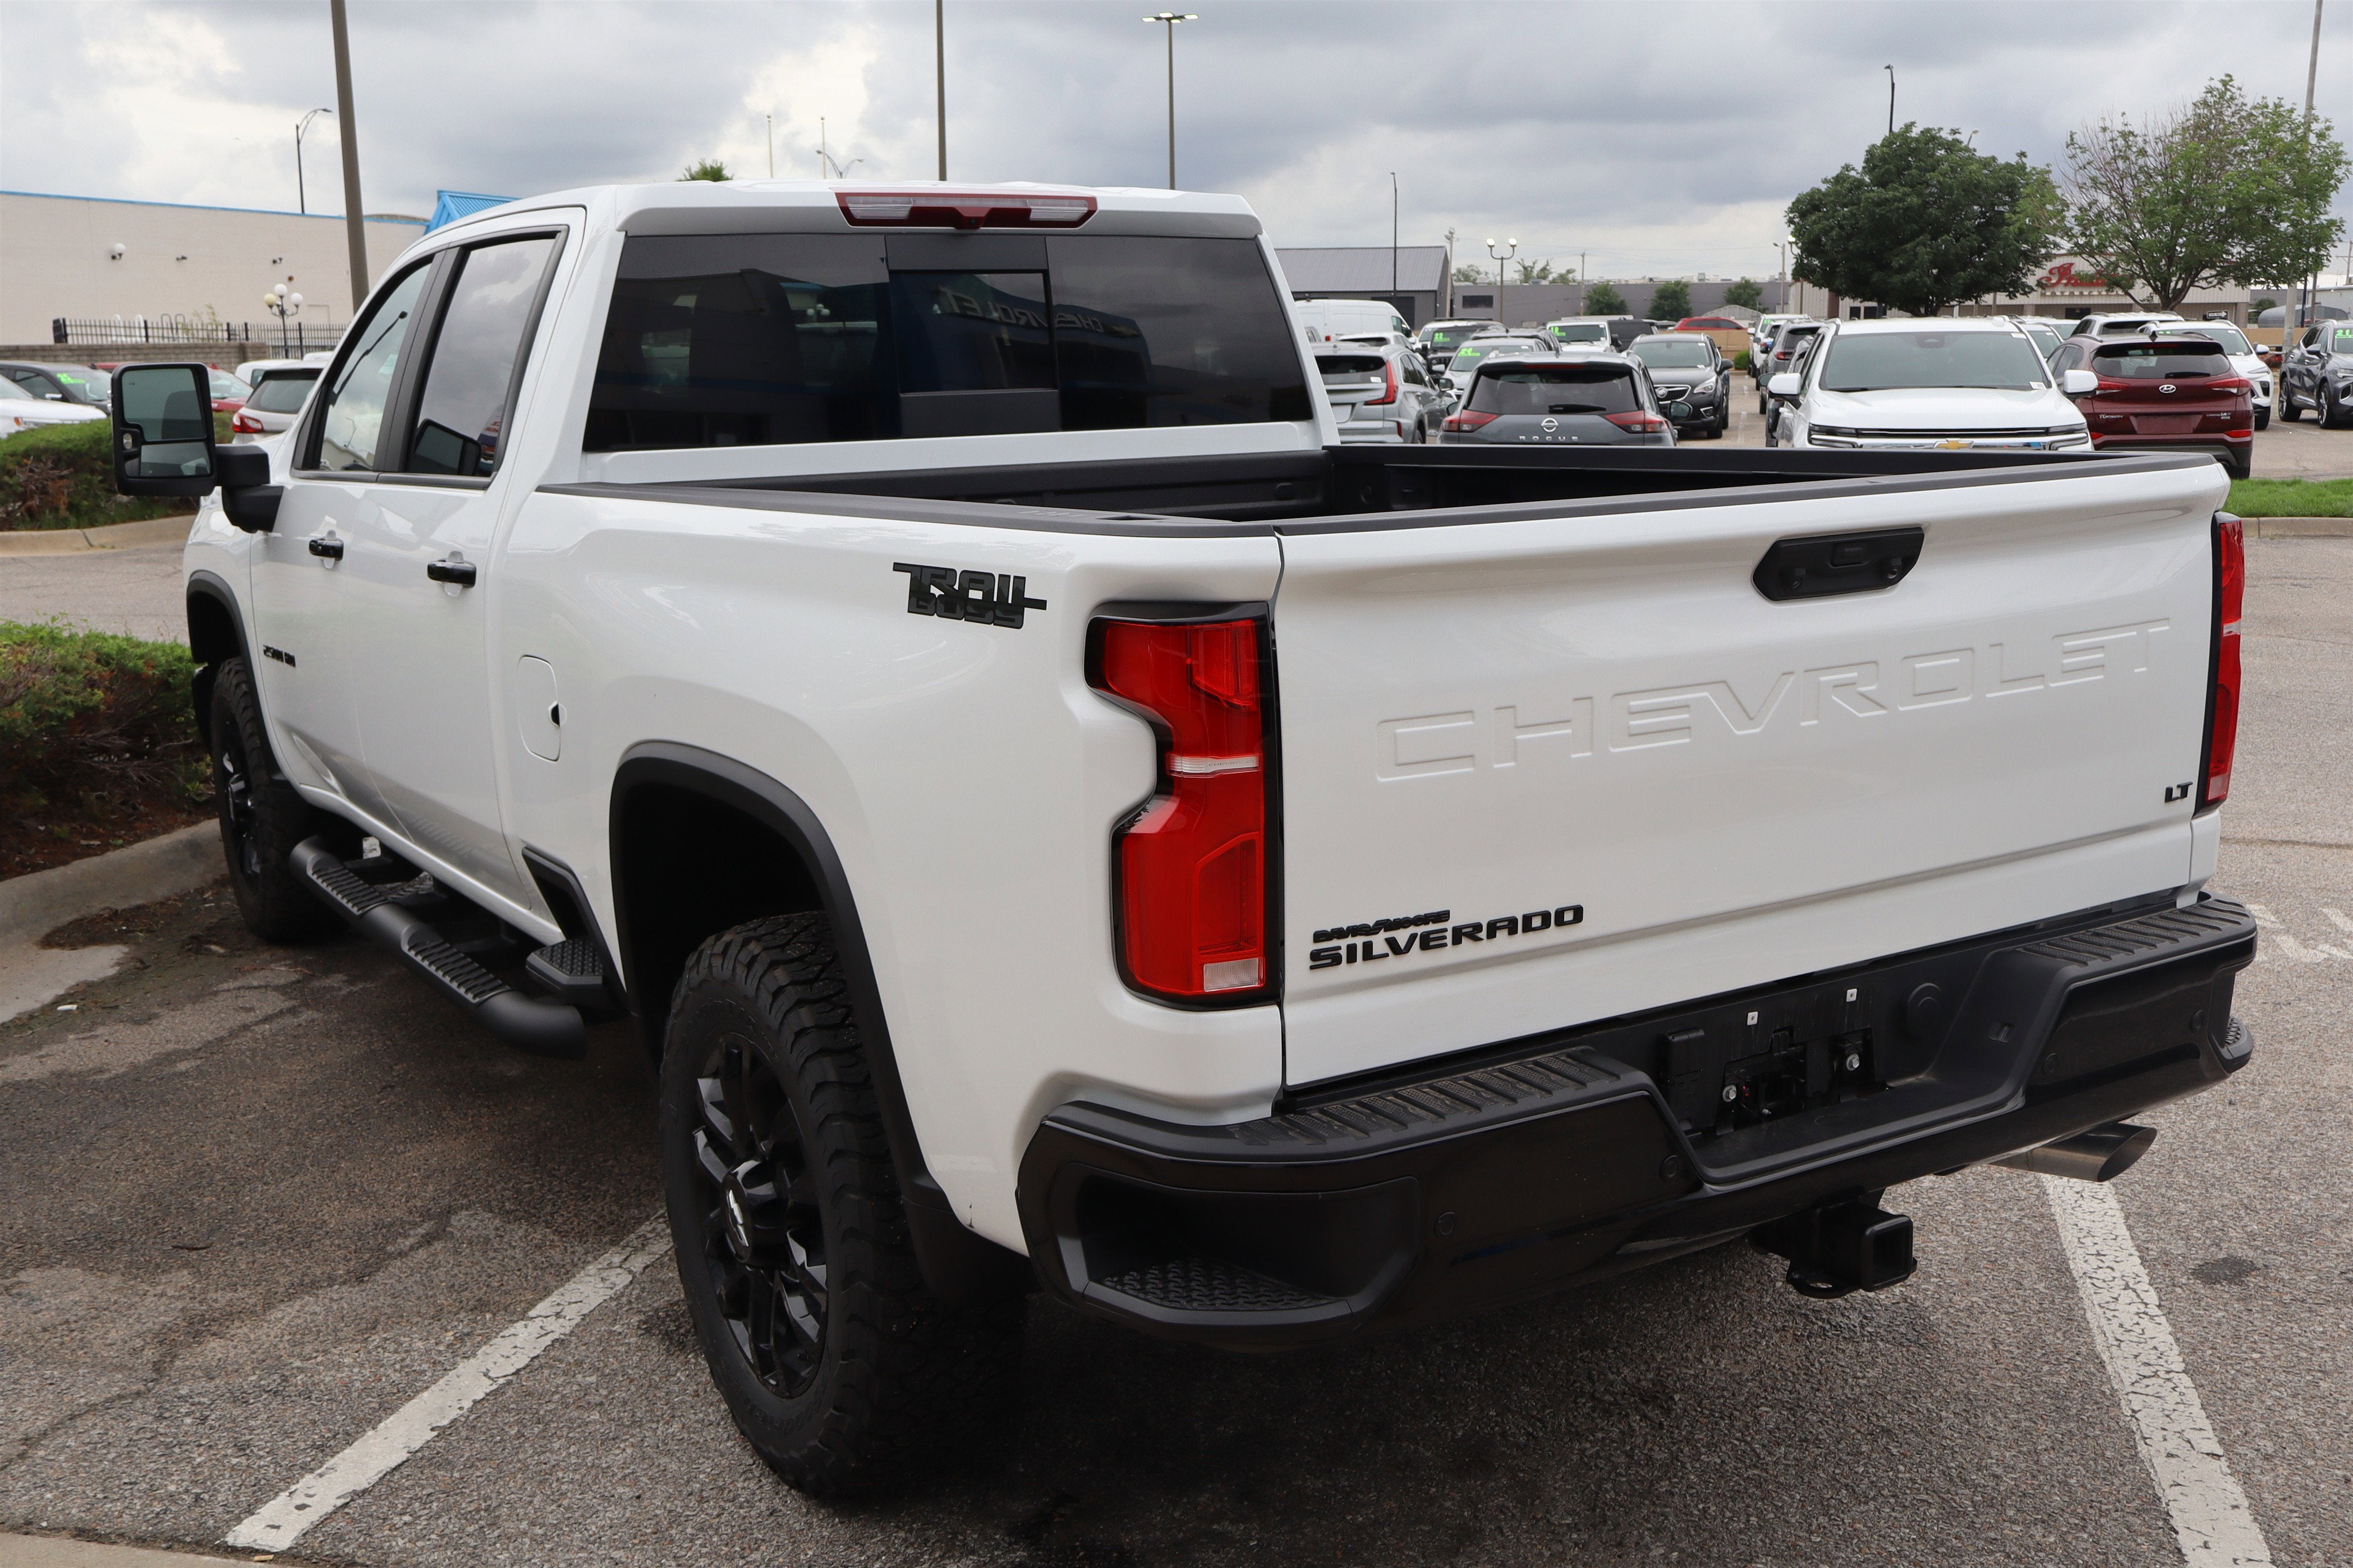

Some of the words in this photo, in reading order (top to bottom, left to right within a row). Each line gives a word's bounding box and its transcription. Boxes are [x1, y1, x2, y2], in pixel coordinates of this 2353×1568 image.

[893, 562, 1047, 611] TRAIL
[1376, 618, 2170, 782] CHEVROLET
[2165, 781, 2193, 802] LT
[1309, 904, 1584, 970] SILVERADO
